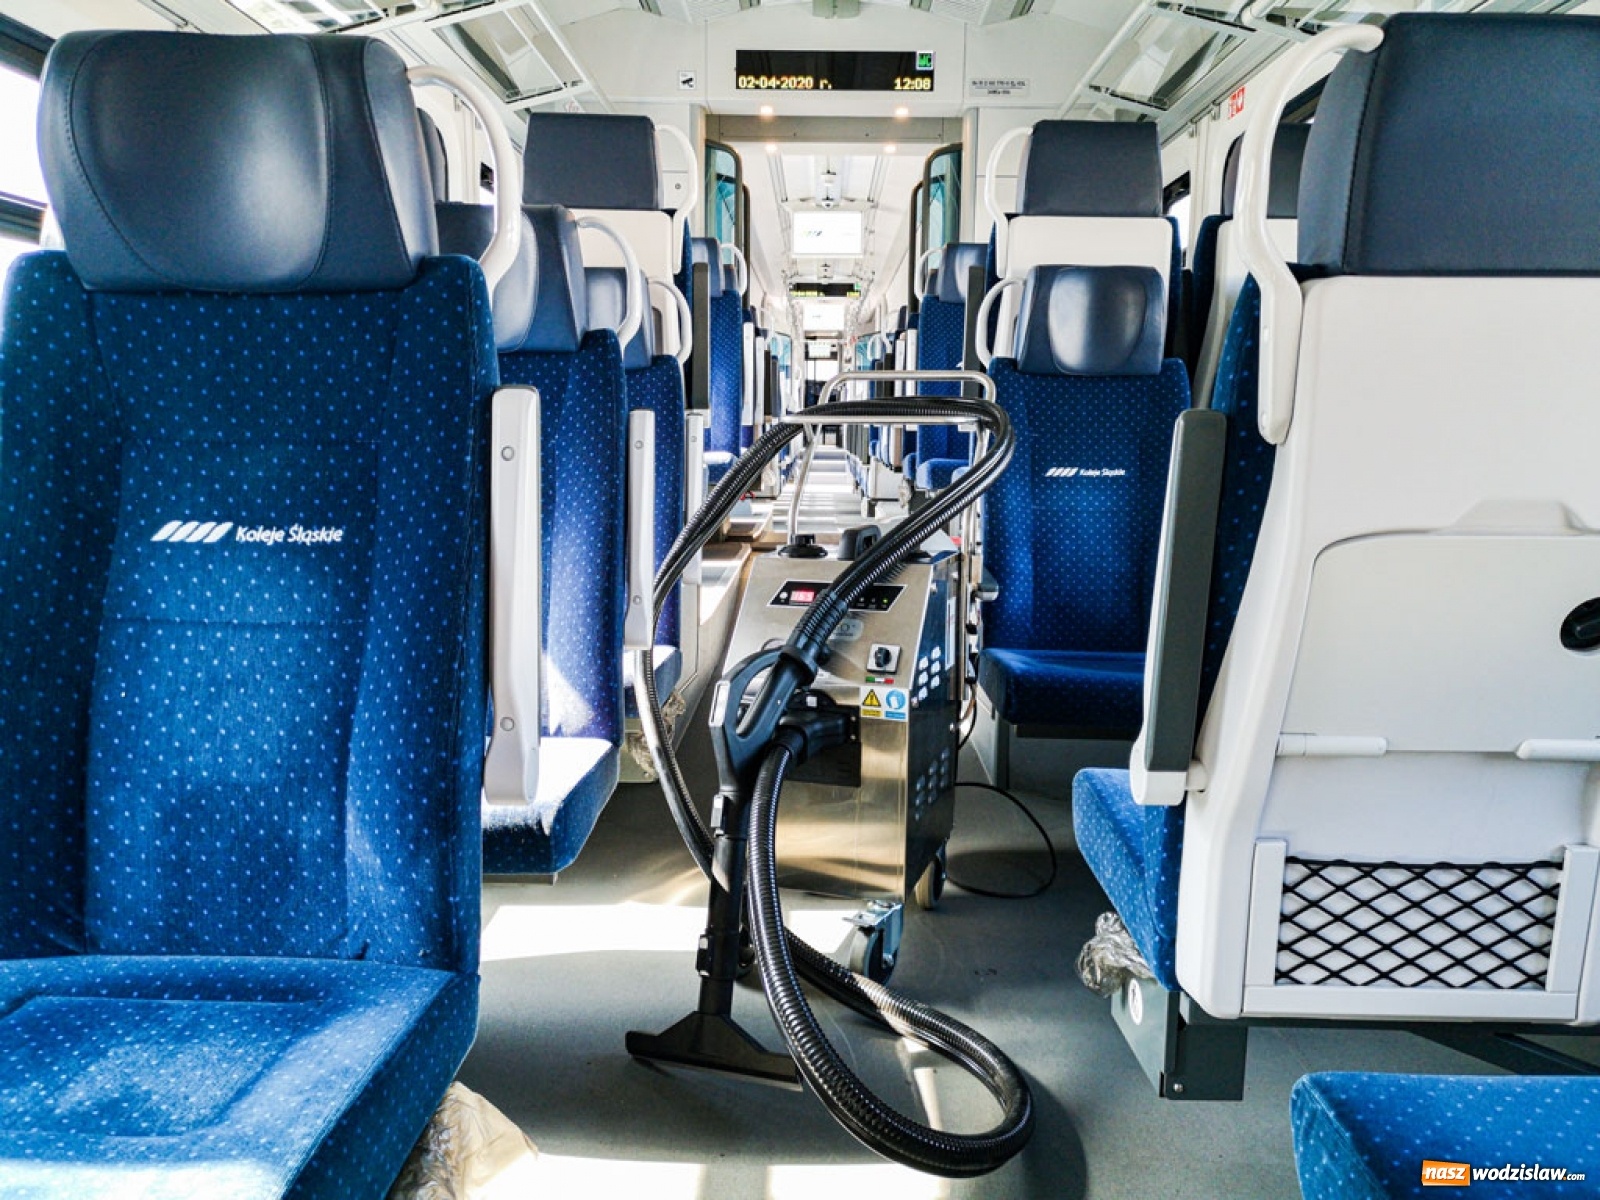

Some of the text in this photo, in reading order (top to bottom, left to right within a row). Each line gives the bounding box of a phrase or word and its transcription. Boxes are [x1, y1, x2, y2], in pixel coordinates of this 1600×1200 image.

[738, 75, 813, 89] 02-04-2020
[894, 77, 931, 90] 12:08
[235, 523, 343, 546] Koleje Śląskie
